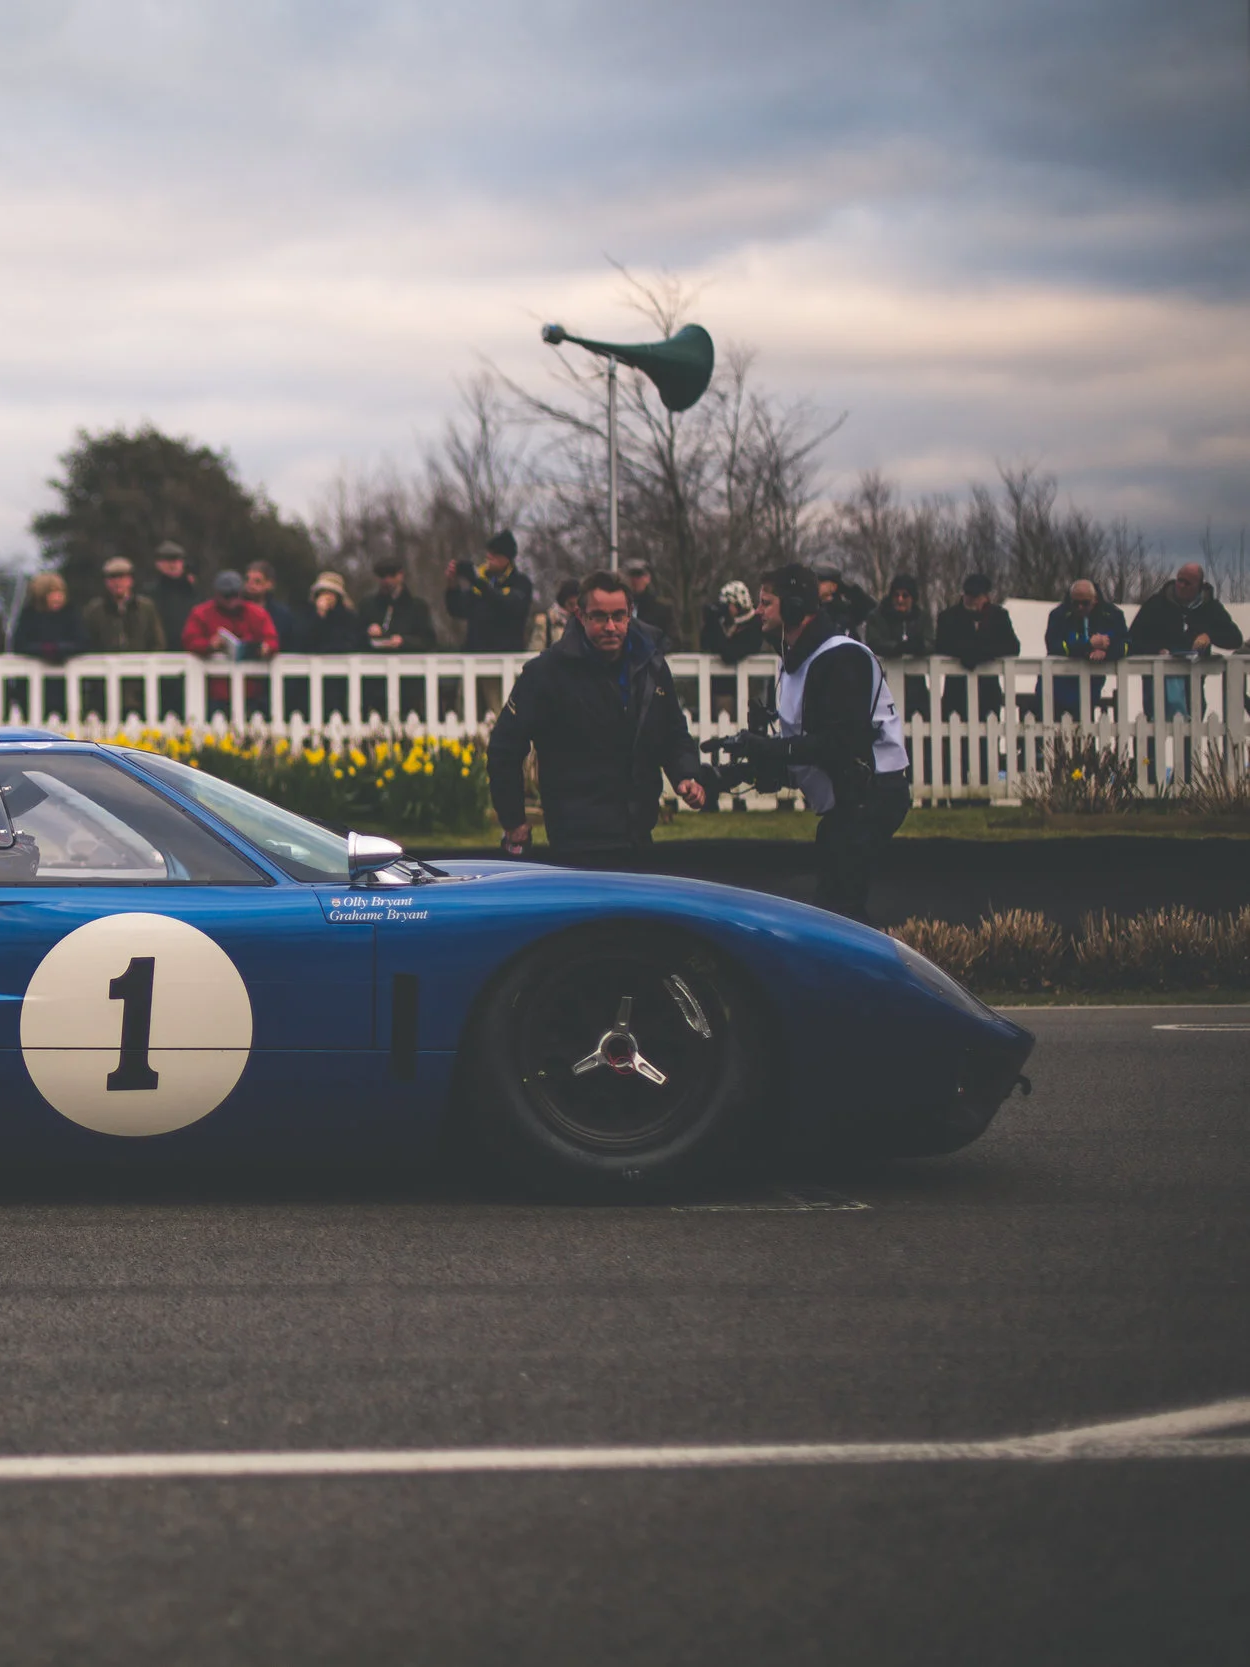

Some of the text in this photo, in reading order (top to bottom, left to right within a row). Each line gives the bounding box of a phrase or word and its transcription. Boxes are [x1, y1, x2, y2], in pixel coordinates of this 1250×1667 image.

[343, 896, 414, 910] Olly Bryant
[330, 909, 429, 922] Grahame Bryant
[106, 956, 159, 1091] 1
